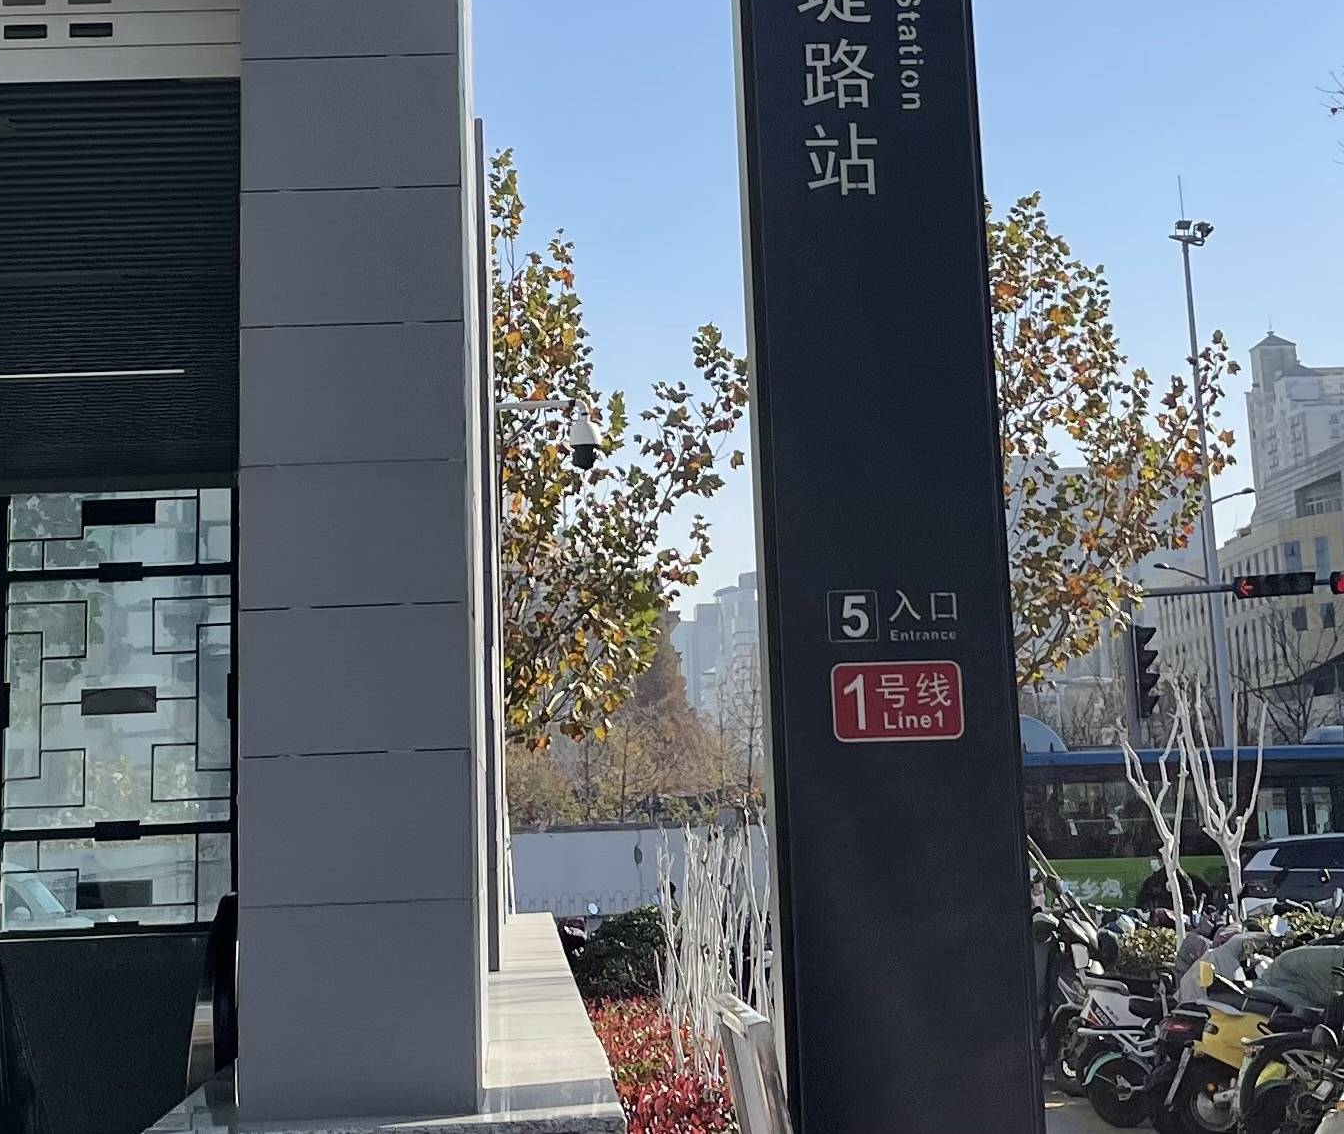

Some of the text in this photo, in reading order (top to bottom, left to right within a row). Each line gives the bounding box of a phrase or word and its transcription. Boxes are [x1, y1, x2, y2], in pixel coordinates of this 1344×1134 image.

[841, 594, 870, 639] 5
[888, 589, 959, 622] 入口
[889, 628, 958, 642] Entrance
[842, 672, 952, 732] 1号线
[882, 710, 944, 730] Line1
